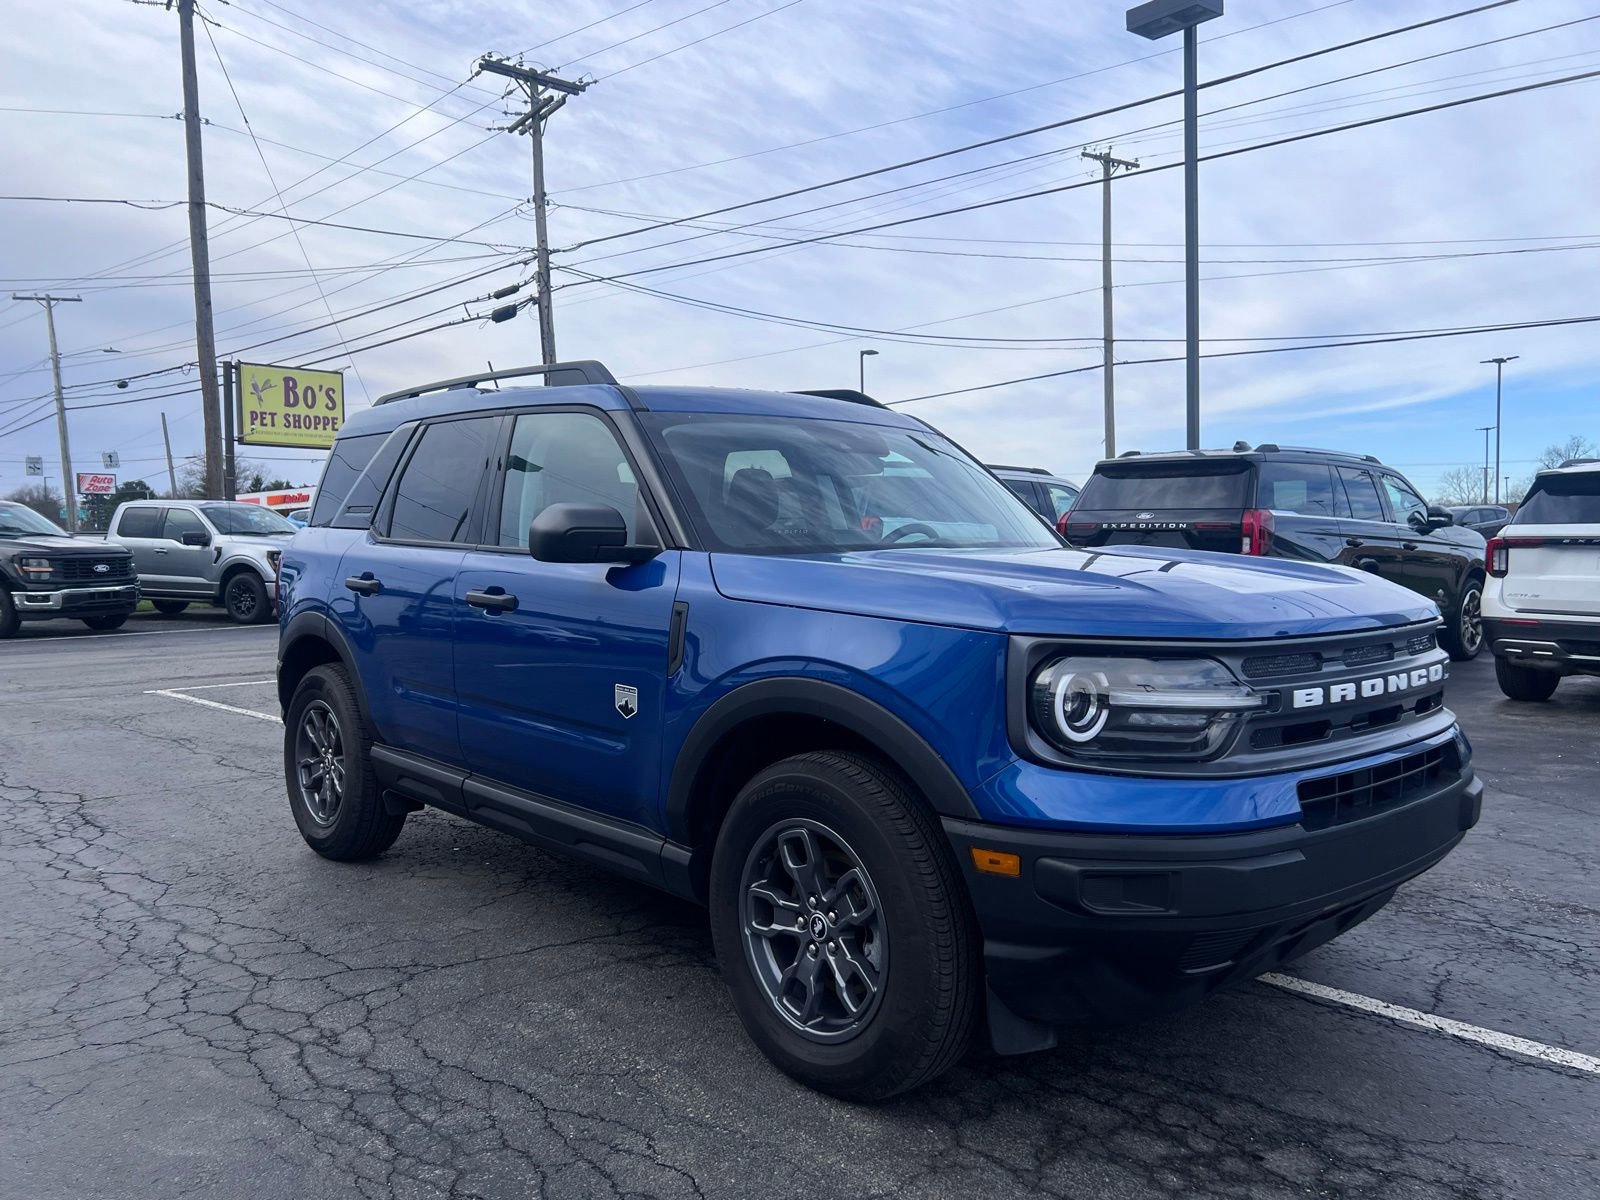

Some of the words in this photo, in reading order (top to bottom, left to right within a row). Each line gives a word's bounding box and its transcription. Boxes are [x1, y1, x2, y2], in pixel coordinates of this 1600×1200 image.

[250, 410, 277, 428] PET
[283, 413, 339, 432] SHOPPE
[90, 475, 113, 484] Auto
[1293, 664, 1443, 708] BRONCO
